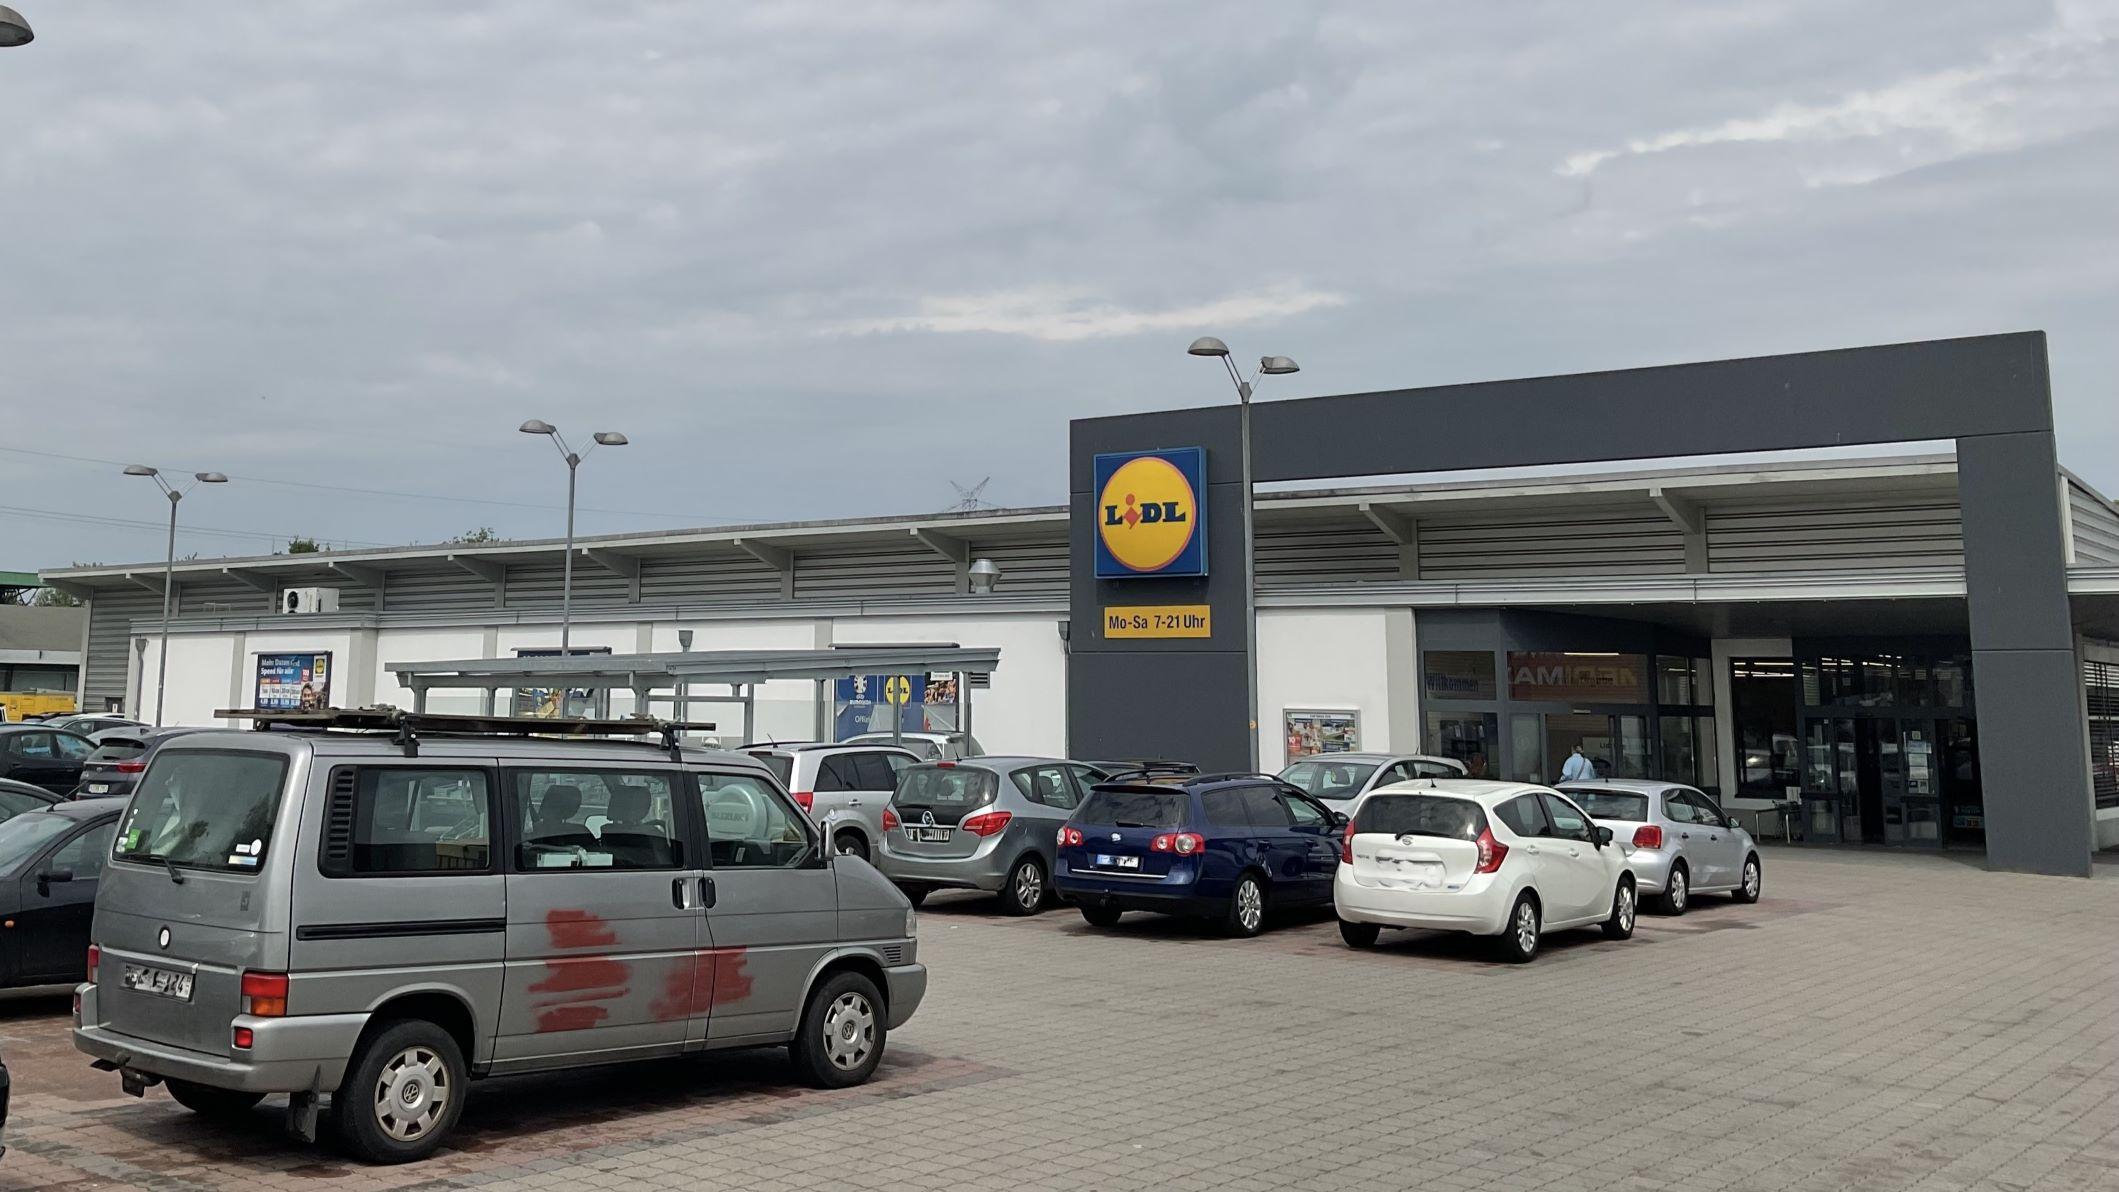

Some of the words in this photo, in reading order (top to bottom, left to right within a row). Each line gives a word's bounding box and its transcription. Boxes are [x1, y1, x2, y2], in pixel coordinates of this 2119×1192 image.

[1105, 494, 1186, 529] LIDL
[1109, 615, 1148, 629] Mo-Sa
[1154, 615, 1180, 629] 7-21
[1184, 614, 1205, 629] Uhr
